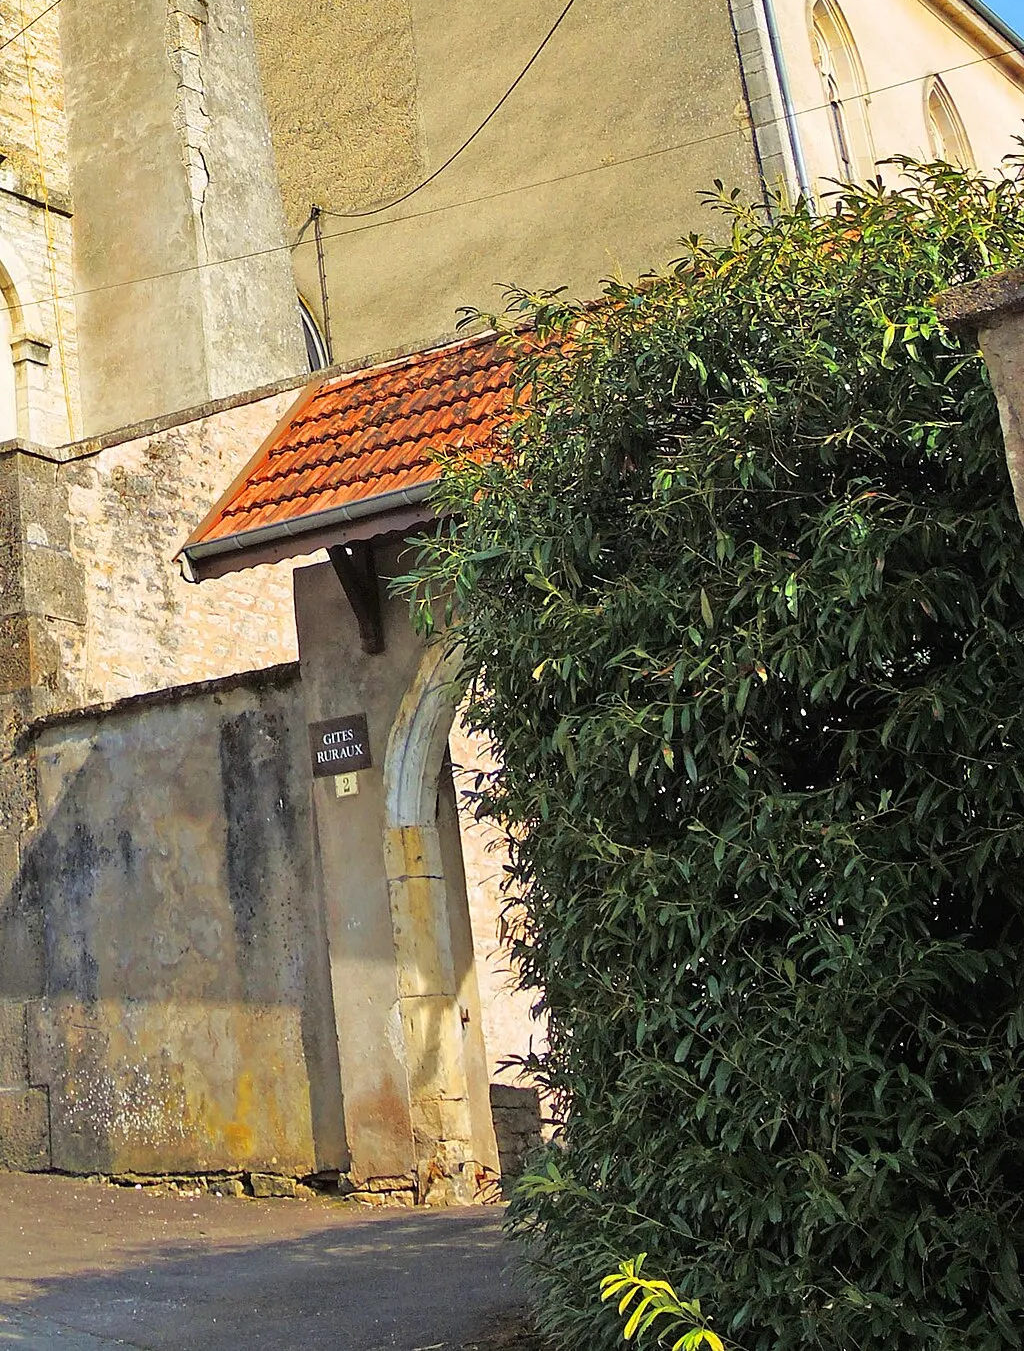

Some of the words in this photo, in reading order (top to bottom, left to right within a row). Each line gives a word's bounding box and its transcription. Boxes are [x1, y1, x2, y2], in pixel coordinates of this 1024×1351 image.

[323, 729, 354, 745] GITES
[317, 744, 364, 763] RURAUX
[342, 777, 350, 792] 2
